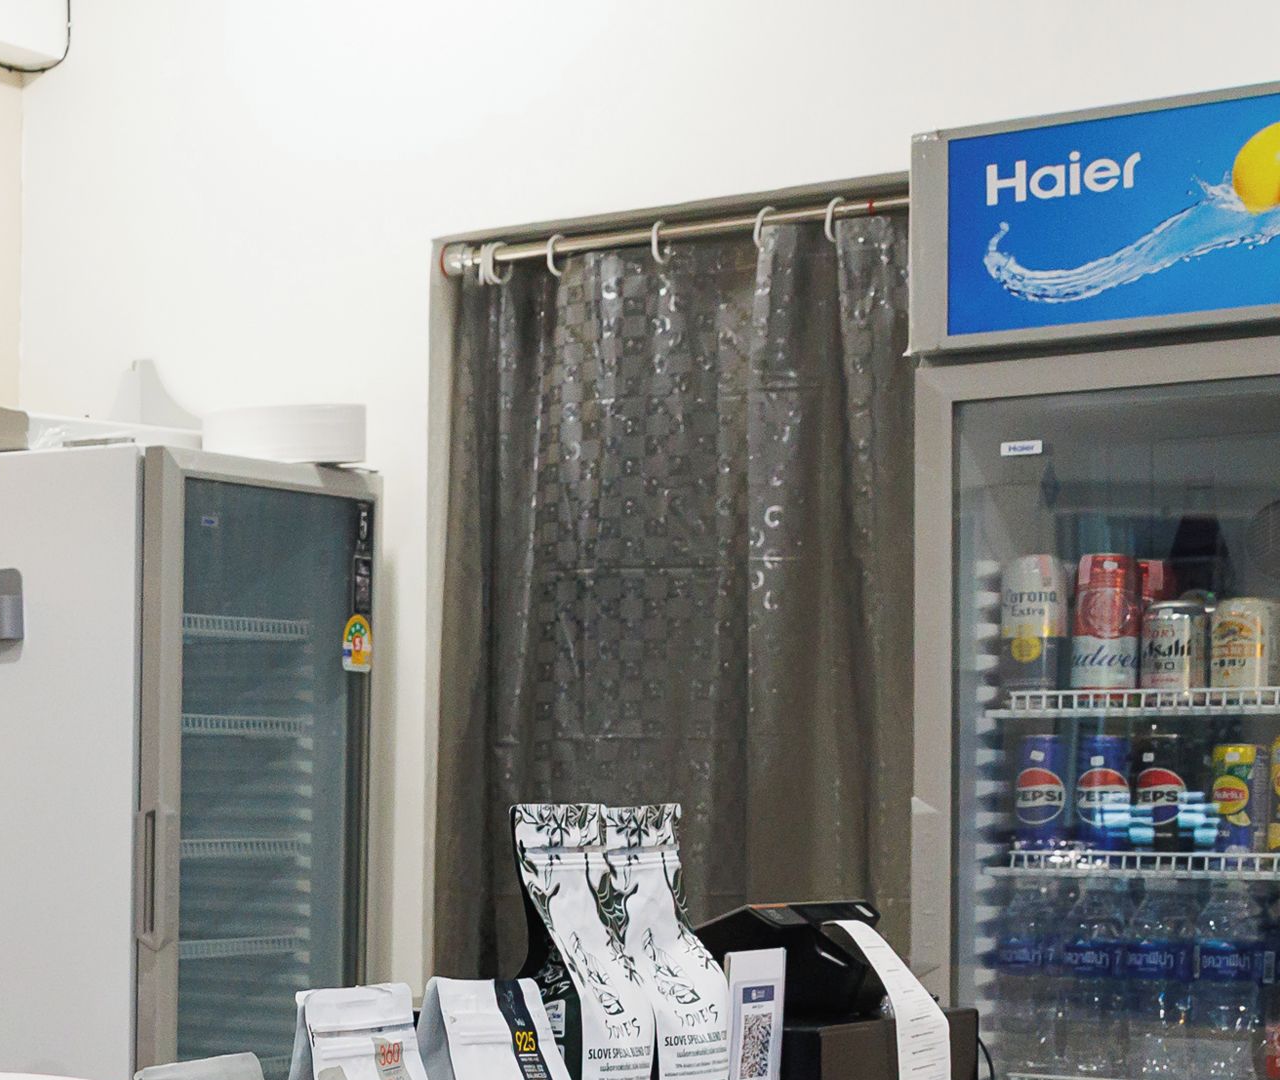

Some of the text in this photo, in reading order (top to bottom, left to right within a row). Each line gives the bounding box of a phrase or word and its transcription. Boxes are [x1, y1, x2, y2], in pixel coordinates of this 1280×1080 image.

[985, 150, 1141, 206] Haier
[1008, 444, 1035, 452] Haier
[515, 1031, 536, 1051] 925
[664, 1034, 687, 1047] SLOVE
[379, 1042, 401, 1067] 360
[587, 1047, 612, 1060] SLOVE
